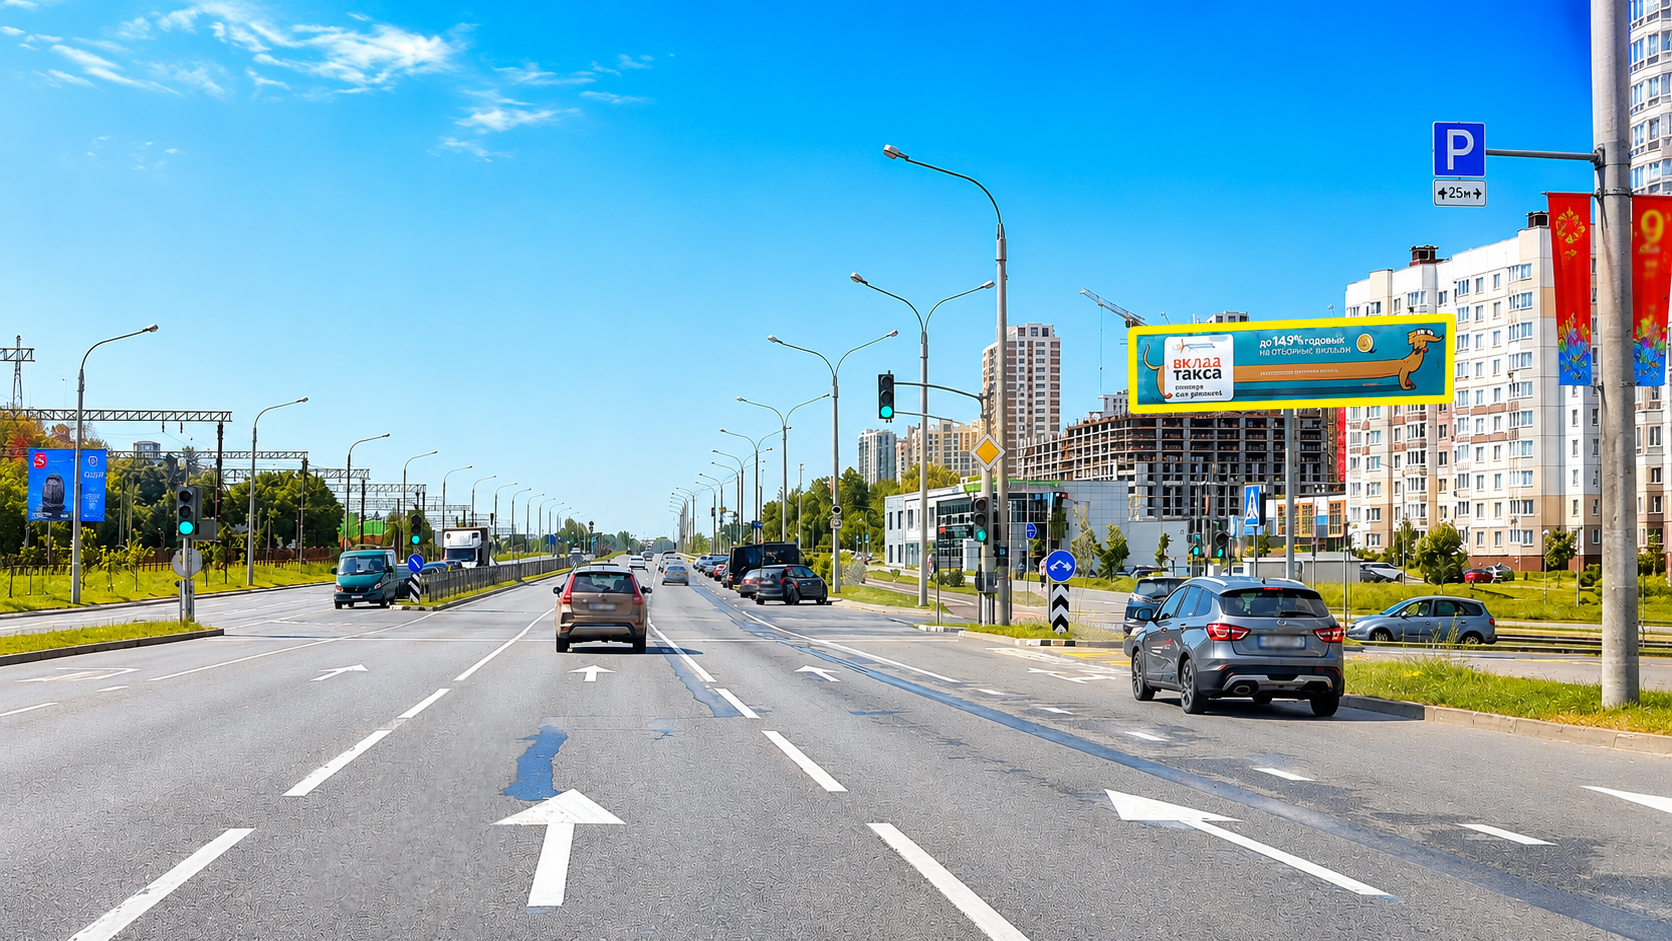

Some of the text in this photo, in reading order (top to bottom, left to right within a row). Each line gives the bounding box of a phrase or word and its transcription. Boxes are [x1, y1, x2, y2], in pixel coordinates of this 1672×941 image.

[1447, 129, 1474, 170] P
[1640, 209, 1664, 244] 9
[1259, 339, 1272, 348] до
[1304, 337, 1345, 346] годовых
[1173, 368, 1222, 381] такса
